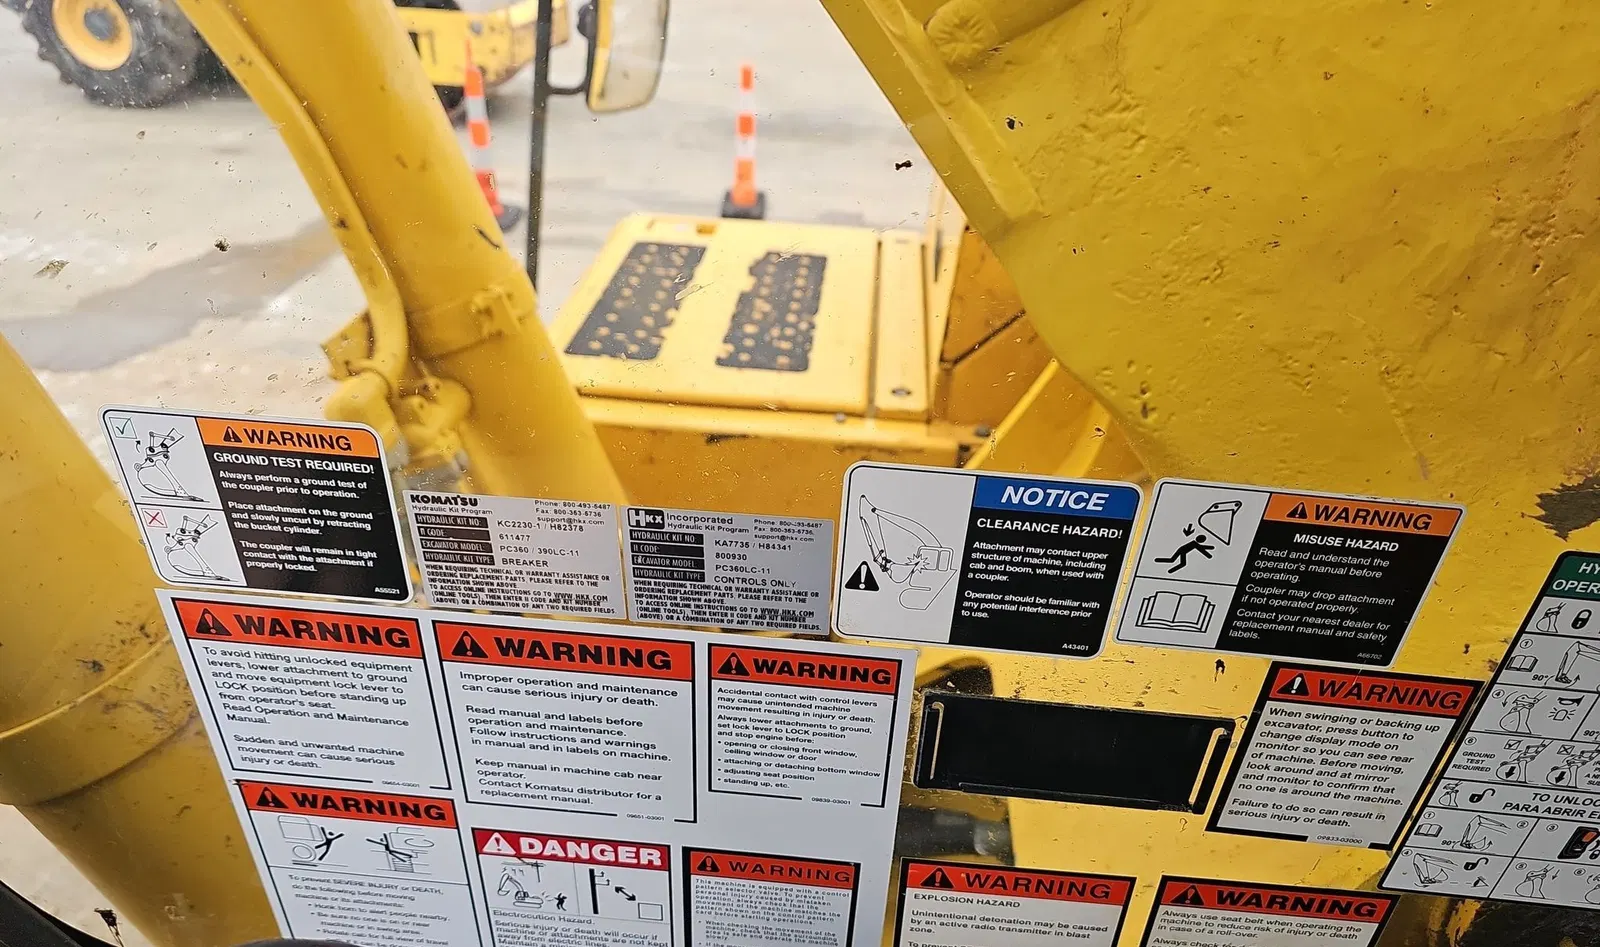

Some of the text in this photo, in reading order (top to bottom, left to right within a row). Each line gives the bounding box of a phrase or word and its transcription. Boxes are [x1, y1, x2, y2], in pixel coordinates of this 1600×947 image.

[244, 428, 353, 452] WARNING
[213, 452, 374, 474] GROUND TEST REQUIRED!
[219, 470, 253, 481] Always
[254, 474, 292, 483] perform
[301, 478, 336, 487] ground
[337, 480, 356, 488] test
[357, 481, 367, 489] of
[221, 481, 359, 498] the coupler prior to operation.
[1001, 486, 1109, 512] NOTICE
[410, 494, 478, 507] KOMATSU
[417, 515, 456, 525] HYDRAULIC
[469, 518, 482, 527] NO:
[497, 520, 540, 529] KC2230-1
[549, 523, 584, 532] H82378
[666, 513, 733, 525] Incorporated
[1314, 503, 1434, 532] WARNING
[499, 533, 530, 542] 611477
[668, 523, 703, 531] Hydraulic
[717, 525, 749, 534] Program
[977, 518, 1123, 539] CLEARANCE HAZARD!
[422, 541, 485, 552] EXCAVATOR MODEL:
[499, 545, 529, 553] PC360
[537, 547, 579, 556] 390LC-11
[714, 540, 749, 548] KA7735
[758, 542, 791, 551] H84341
[973, 541, 1109, 560] Attachment may contact upper
[1293, 533, 1399, 551] MISUSE HAZARD
[501, 557, 549, 568] BREAKER
[715, 552, 747, 561] 800930
[971, 552, 1011, 561] structure
[1023, 557, 1063, 567] machine,
[1065, 559, 1106, 571] including
[1259, 547, 1389, 567] Read and understand the
[715, 564, 770, 574] PC360LC-11
[1254, 560, 1382, 578] operator's manual before
[714, 576, 796, 588] CONTROLS ONLY
[964, 590, 1003, 600] Operator
[1004, 594, 1035, 603] should
[1035, 596, 1047, 604] be
[1048, 597, 1081, 606] familiar
[234, 614, 411, 649] WARNING
[494, 637, 672, 671] WARNING
[1062, 643, 1089, 651] A43401
[203, 646, 413, 672] To avoid hitting unlocked equipment
[753, 658, 892, 685] WARNING
[214, 680, 407, 706] LOCK position before standing up
[460, 671, 678, 697] Improper operation and maintenance
[486, 686, 521, 695] cause
[524, 689, 567, 699] serious
[570, 692, 603, 703] injury
[621, 696, 658, 706] death.
[717, 687, 762, 696] Accidental
[851, 699, 877, 707] levers
[1318, 679, 1463, 710] WARNING
[1269, 707, 1302, 718] When
[1304, 712, 1357, 725] swinging
[1374, 718, 1422, 732] backing
[1424, 725, 1440, 733] up
[469, 726, 506, 736] Follow
[510, 730, 577, 743] instructions
[604, 740, 656, 751] warnings
[1462, 751, 1496, 759] GROUND
[724, 768, 761, 777] adjusting
[1451, 764, 1491, 772] REQUIRED
[291, 792, 447, 821] WARNING
[1532, 793, 1551, 802] TO
[1502, 802, 1587, 818] PARA ABRIR
[520, 837, 662, 866] DANGER
[729, 861, 850, 883] WARNING
[965, 872, 1112, 900] WARNING
[914, 893, 1021, 908] EXPLOSION HAZARD
[1216, 890, 1380, 918] WARNING
[493, 909, 595, 925] Electrocution Hazard.
[912, 910, 977, 921] Unintentional
[979, 916, 1031, 925] detonation
[1072, 924, 1108, 932] caused
[1161, 910, 1197, 919] Always
[1242, 916, 1264, 924] belt
[1266, 919, 1293, 927] when
[1295, 920, 1343, 933] operating
